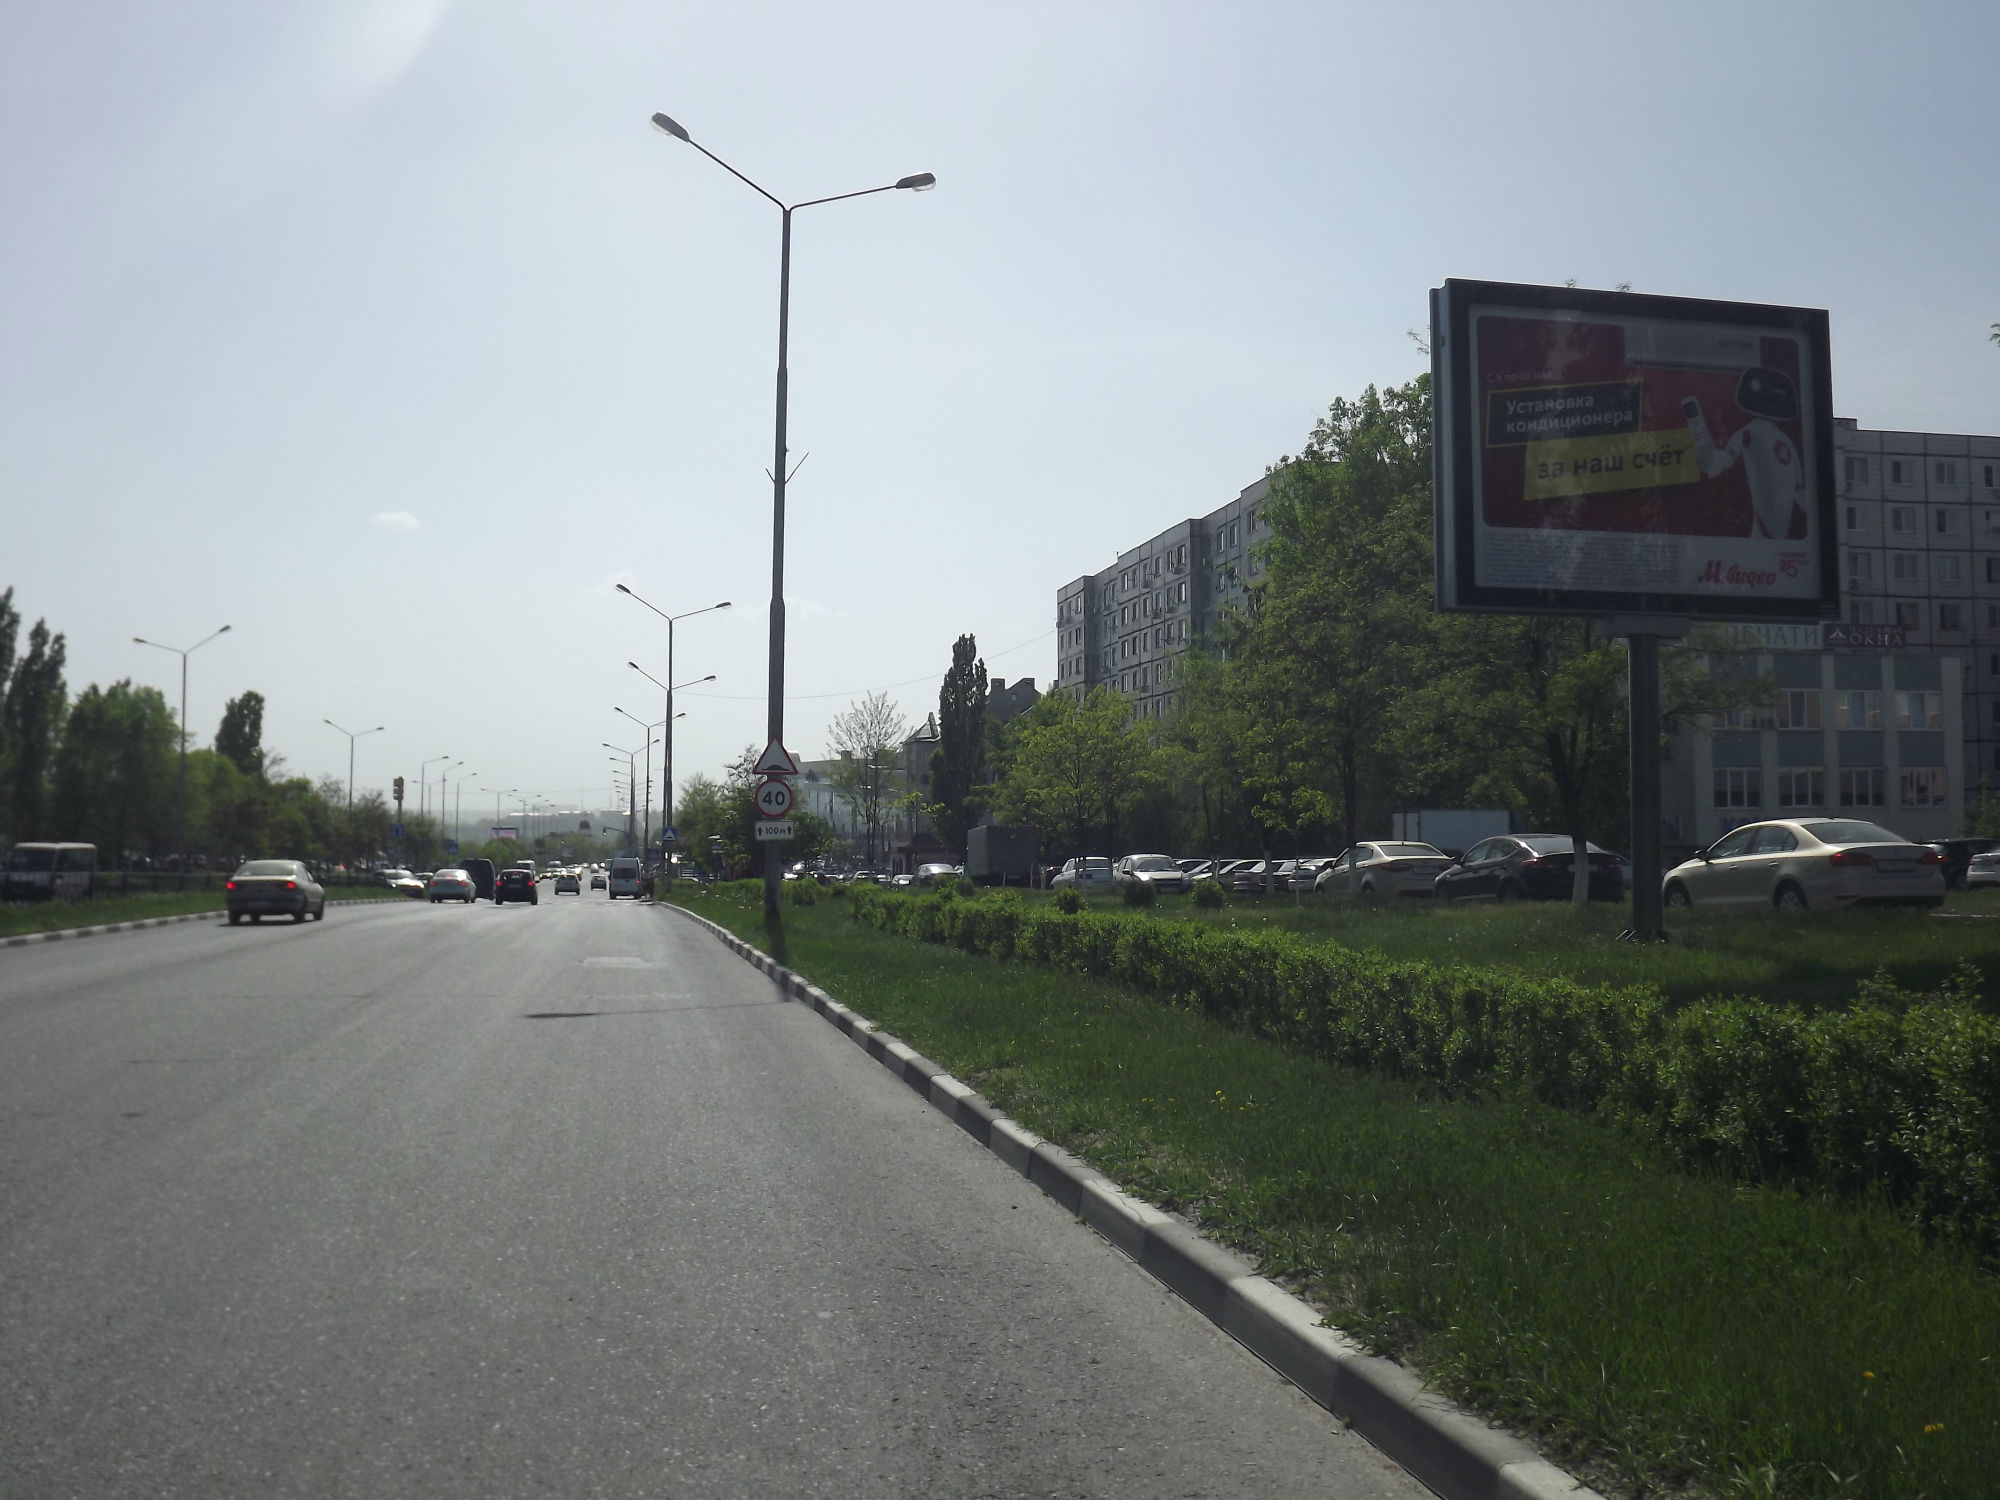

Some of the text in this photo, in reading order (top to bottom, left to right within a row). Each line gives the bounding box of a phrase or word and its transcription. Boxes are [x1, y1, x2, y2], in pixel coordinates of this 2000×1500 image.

[1506, 396, 1594, 414] Установка
[1507, 410, 1633, 433] кондиционера
[1539, 461, 1565, 480] за
[1573, 455, 1623, 476] наш
[1850, 632, 1903, 646] ОКНА
[762, 791, 785, 806] 40
[766, 827, 779, 835] 100
